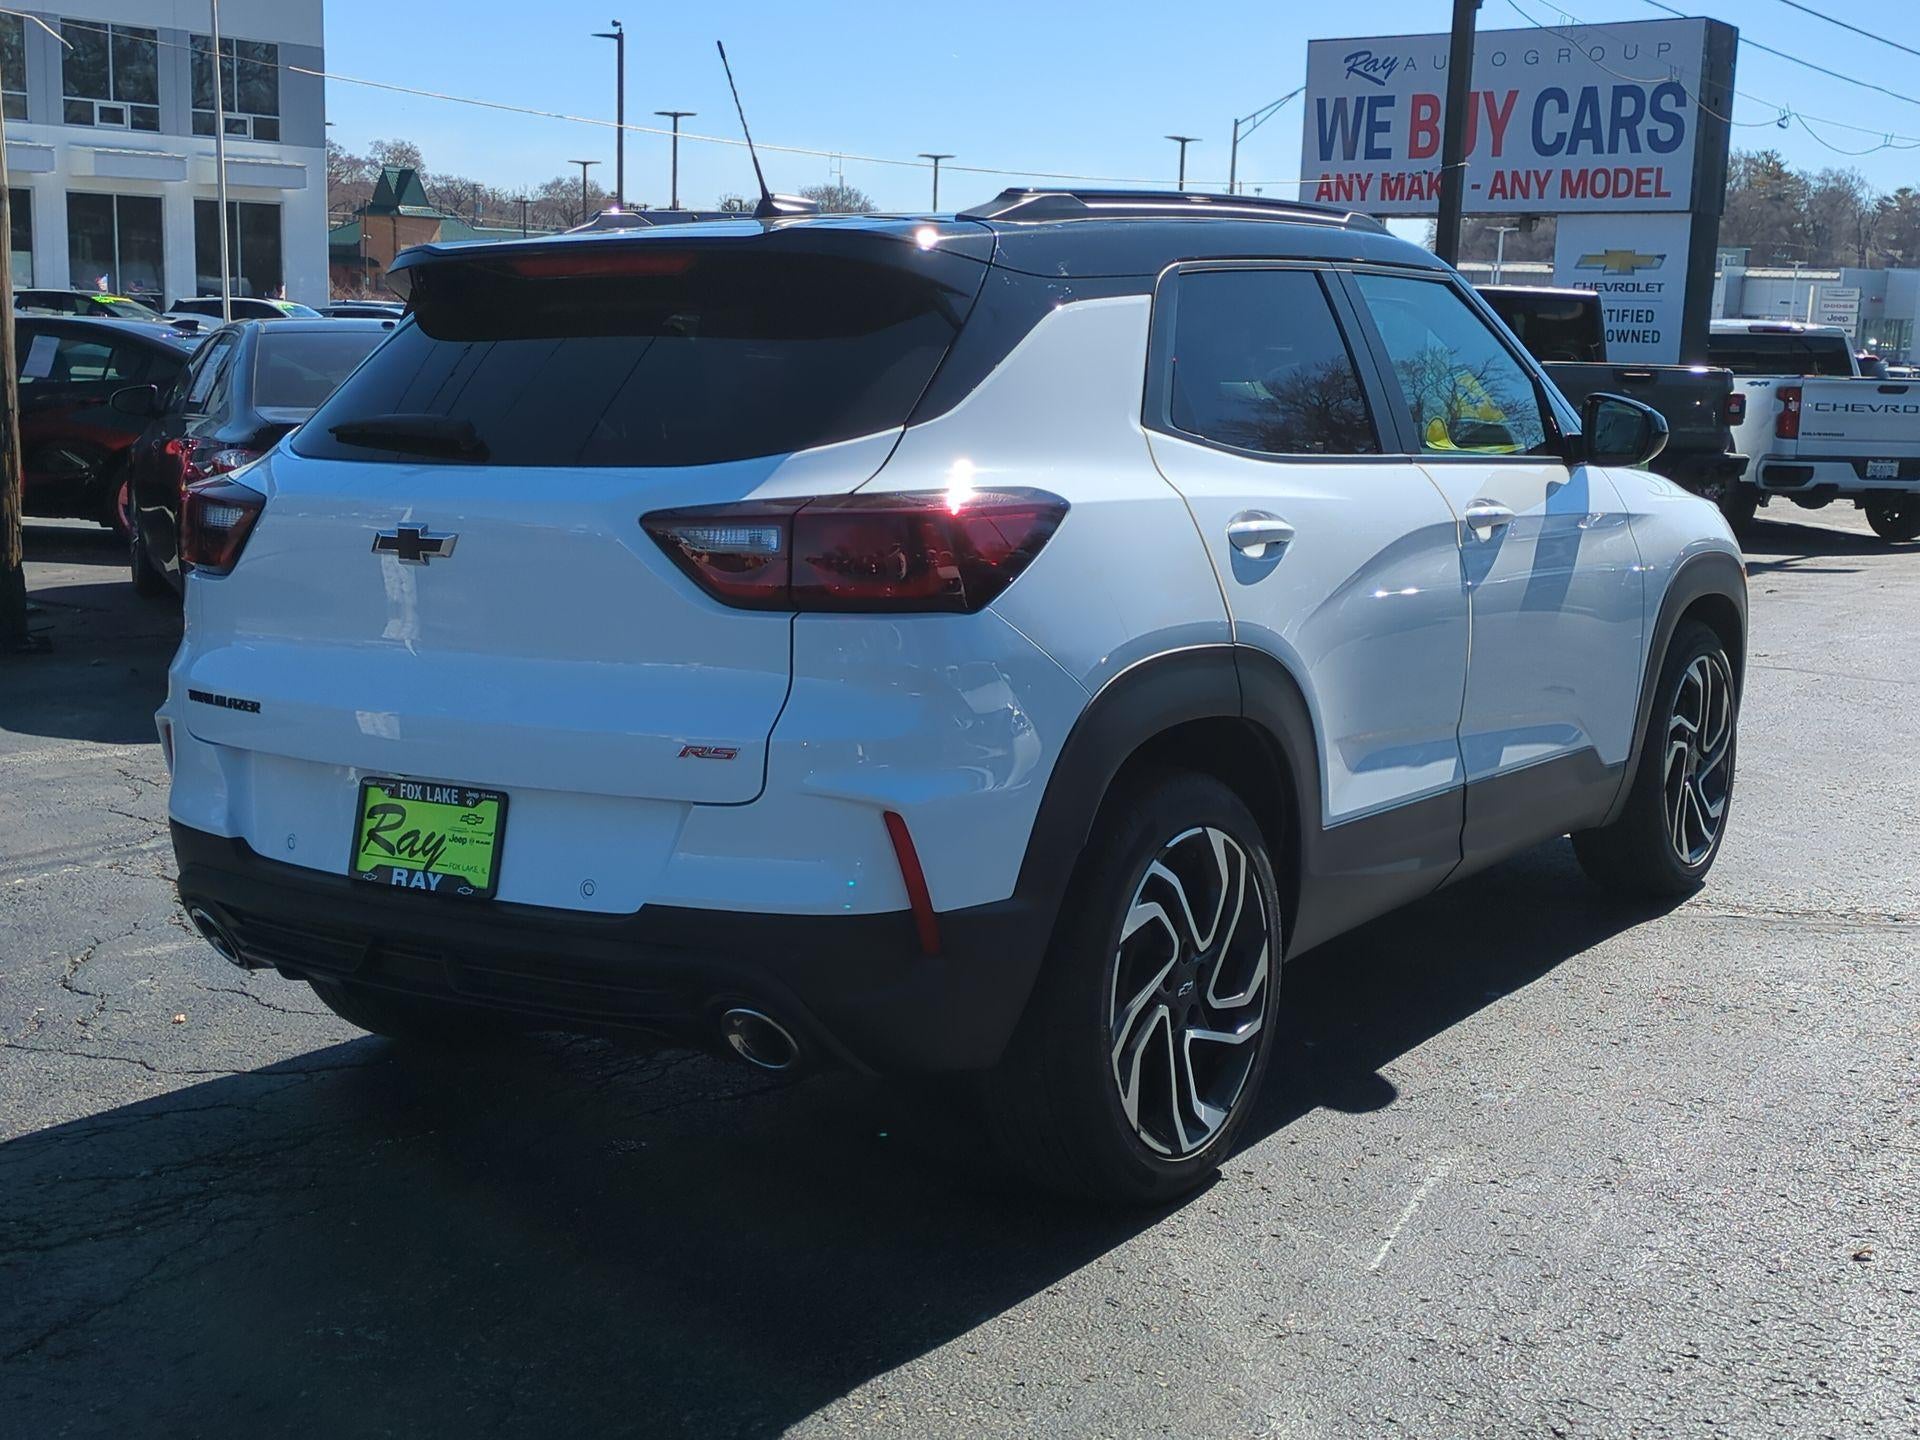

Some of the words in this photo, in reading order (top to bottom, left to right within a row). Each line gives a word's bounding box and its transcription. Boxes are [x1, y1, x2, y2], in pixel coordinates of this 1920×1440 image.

[1343, 50, 1399, 86] Ray
[1404, 42, 1672, 72] AUOGROUP
[1316, 94, 1396, 161] WE
[1531, 82, 1687, 157] CARS
[1315, 172, 1373, 202] ANY
[1380, 171, 1442, 201] MAK
[1488, 168, 1552, 200] ANY
[1560, 167, 1672, 199] MODEL
[1573, 281, 1664, 293] CHEVROLET
[1604, 308, 1655, 323] TIFIED
[1826, 314, 1849, 322] Jeep
[676, 744, 741, 760] RS
[400, 783, 423, 800] FOX
[426, 786, 459, 805] LAKE
[361, 803, 447, 872] Ray
[391, 867, 443, 891] RAY
